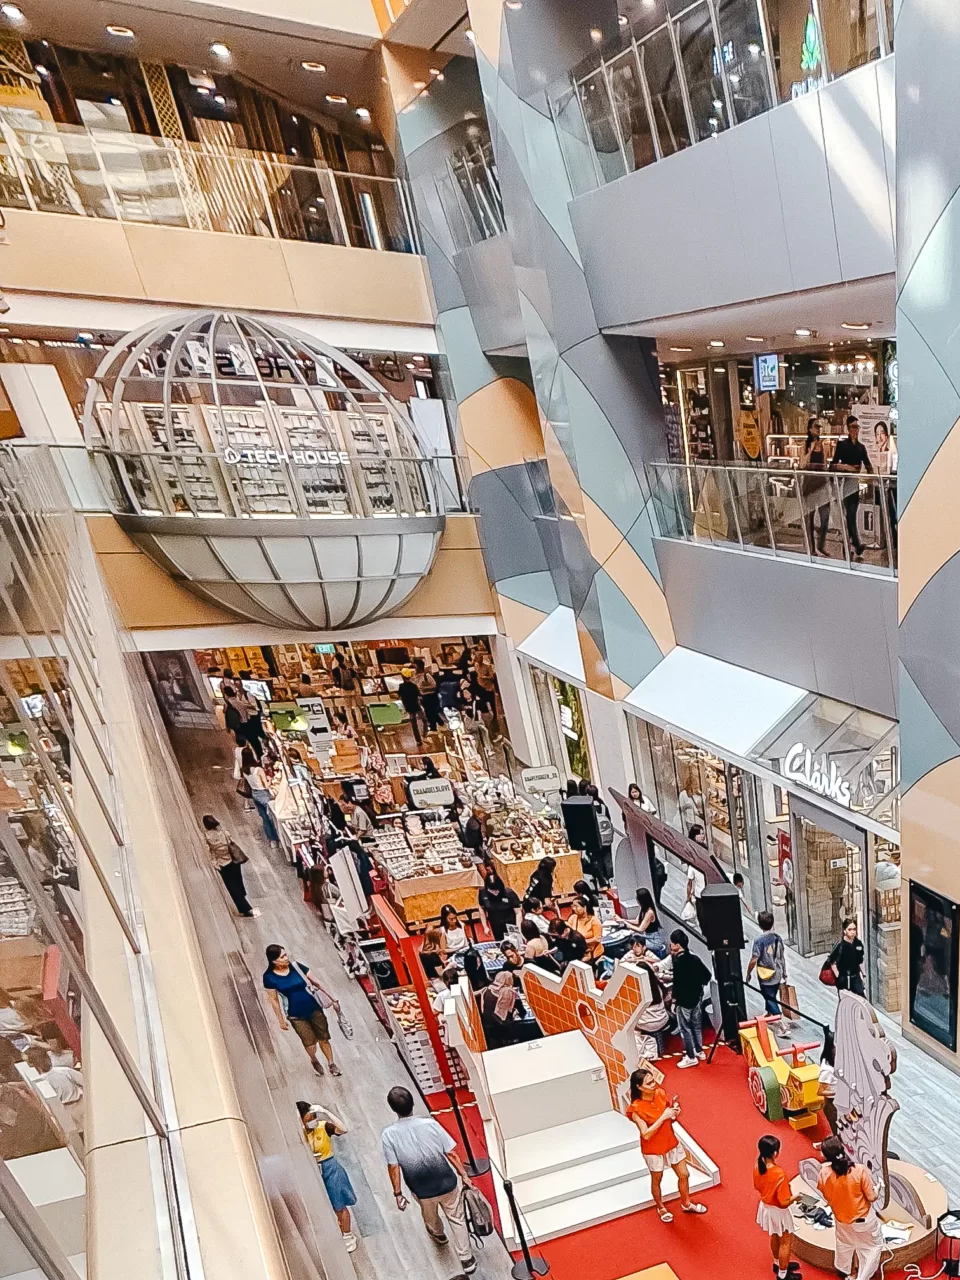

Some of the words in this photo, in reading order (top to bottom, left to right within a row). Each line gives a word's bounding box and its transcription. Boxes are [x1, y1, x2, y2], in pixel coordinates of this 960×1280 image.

[243, 449, 290, 464] TECH
[292, 450, 350, 465] HOUSE
[785, 742, 851, 809] Clarks
